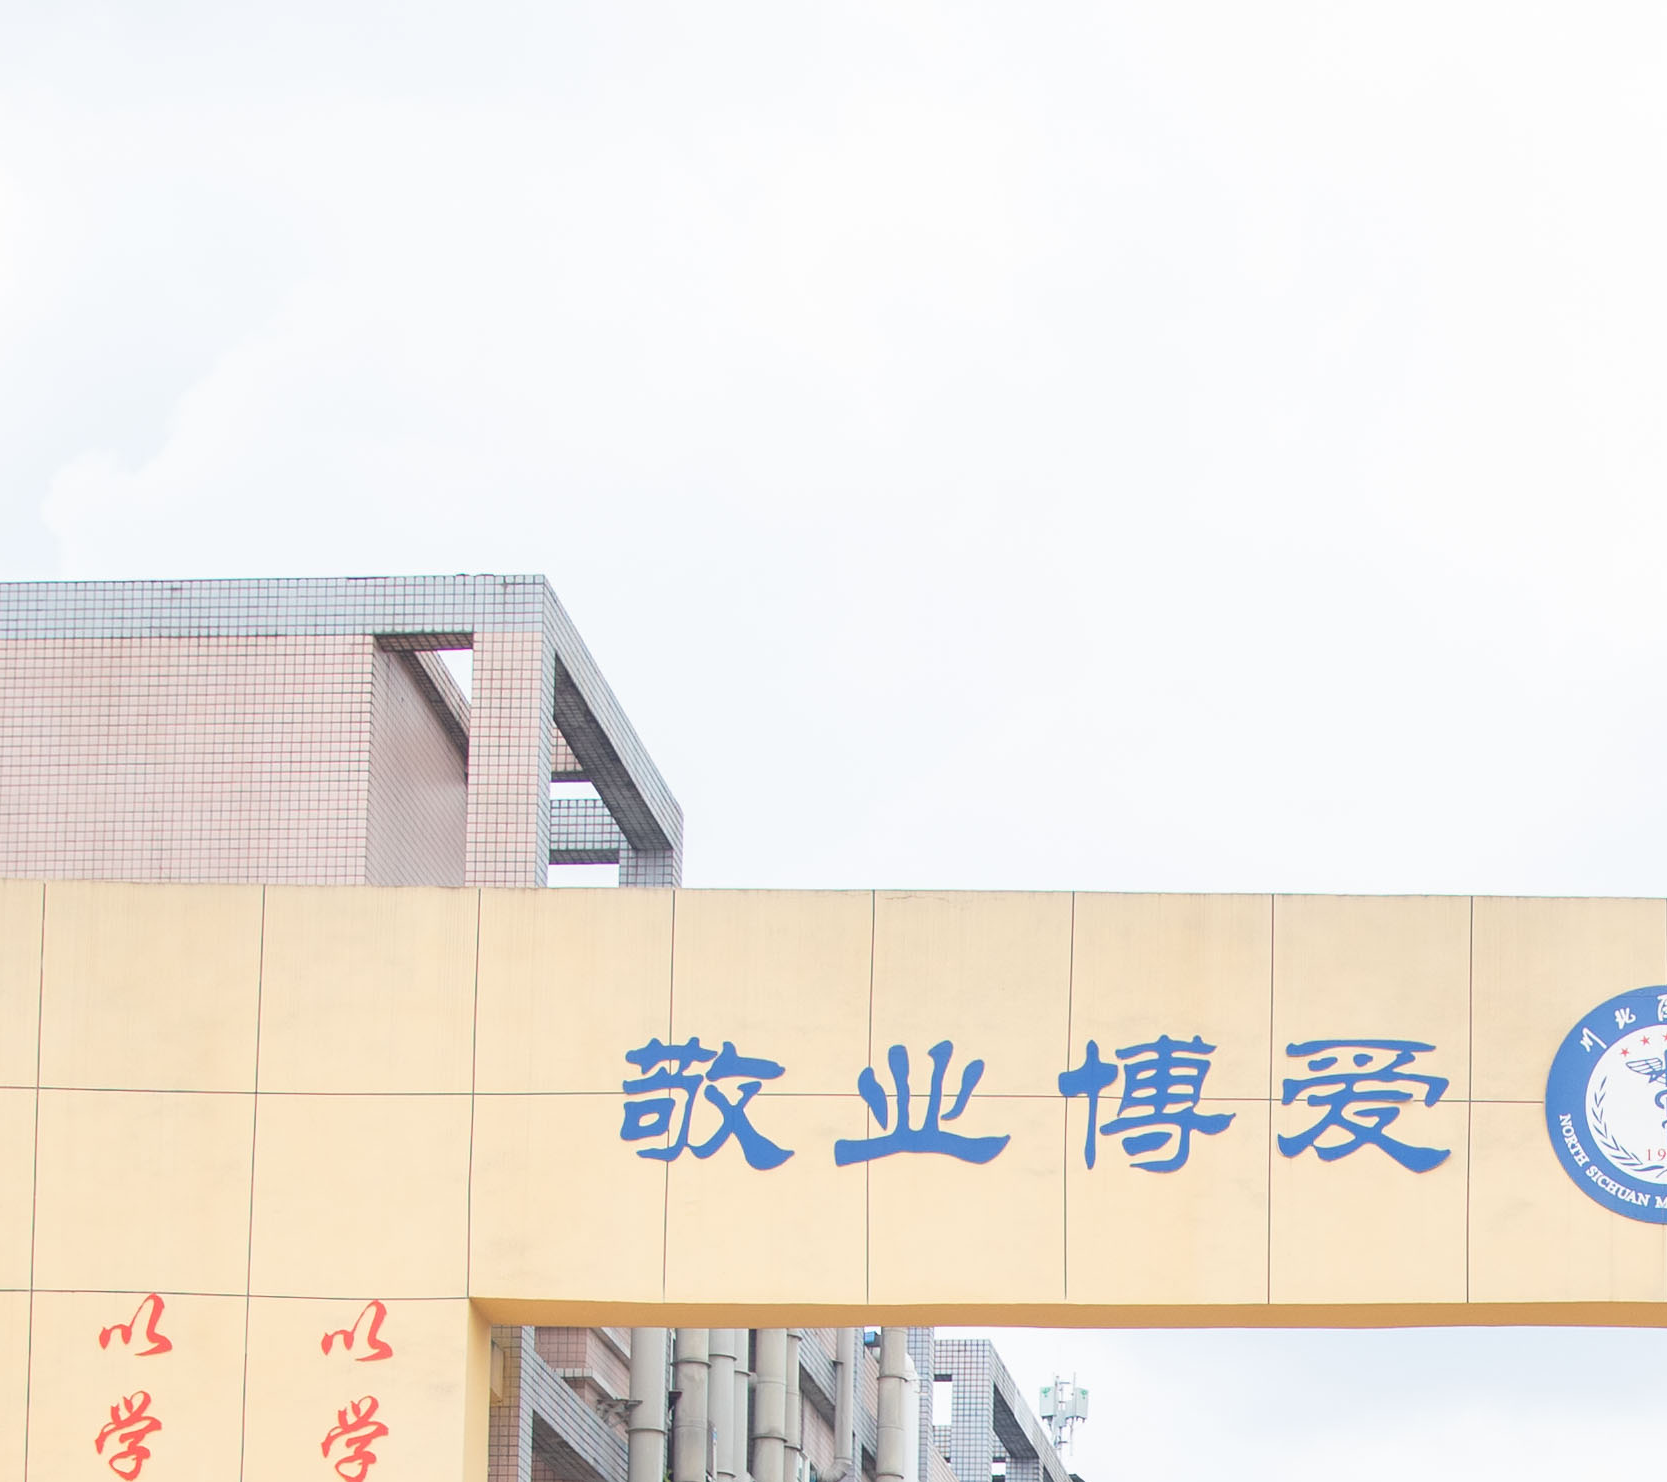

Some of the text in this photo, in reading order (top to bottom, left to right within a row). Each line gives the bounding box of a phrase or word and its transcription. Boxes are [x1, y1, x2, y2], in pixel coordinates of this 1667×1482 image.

[620, 1035, 1451, 1172] 敬业博爱
[1559, 1112, 1590, 1167] NORTH
[1585, 1166, 1651, 1207] SICHUAN
